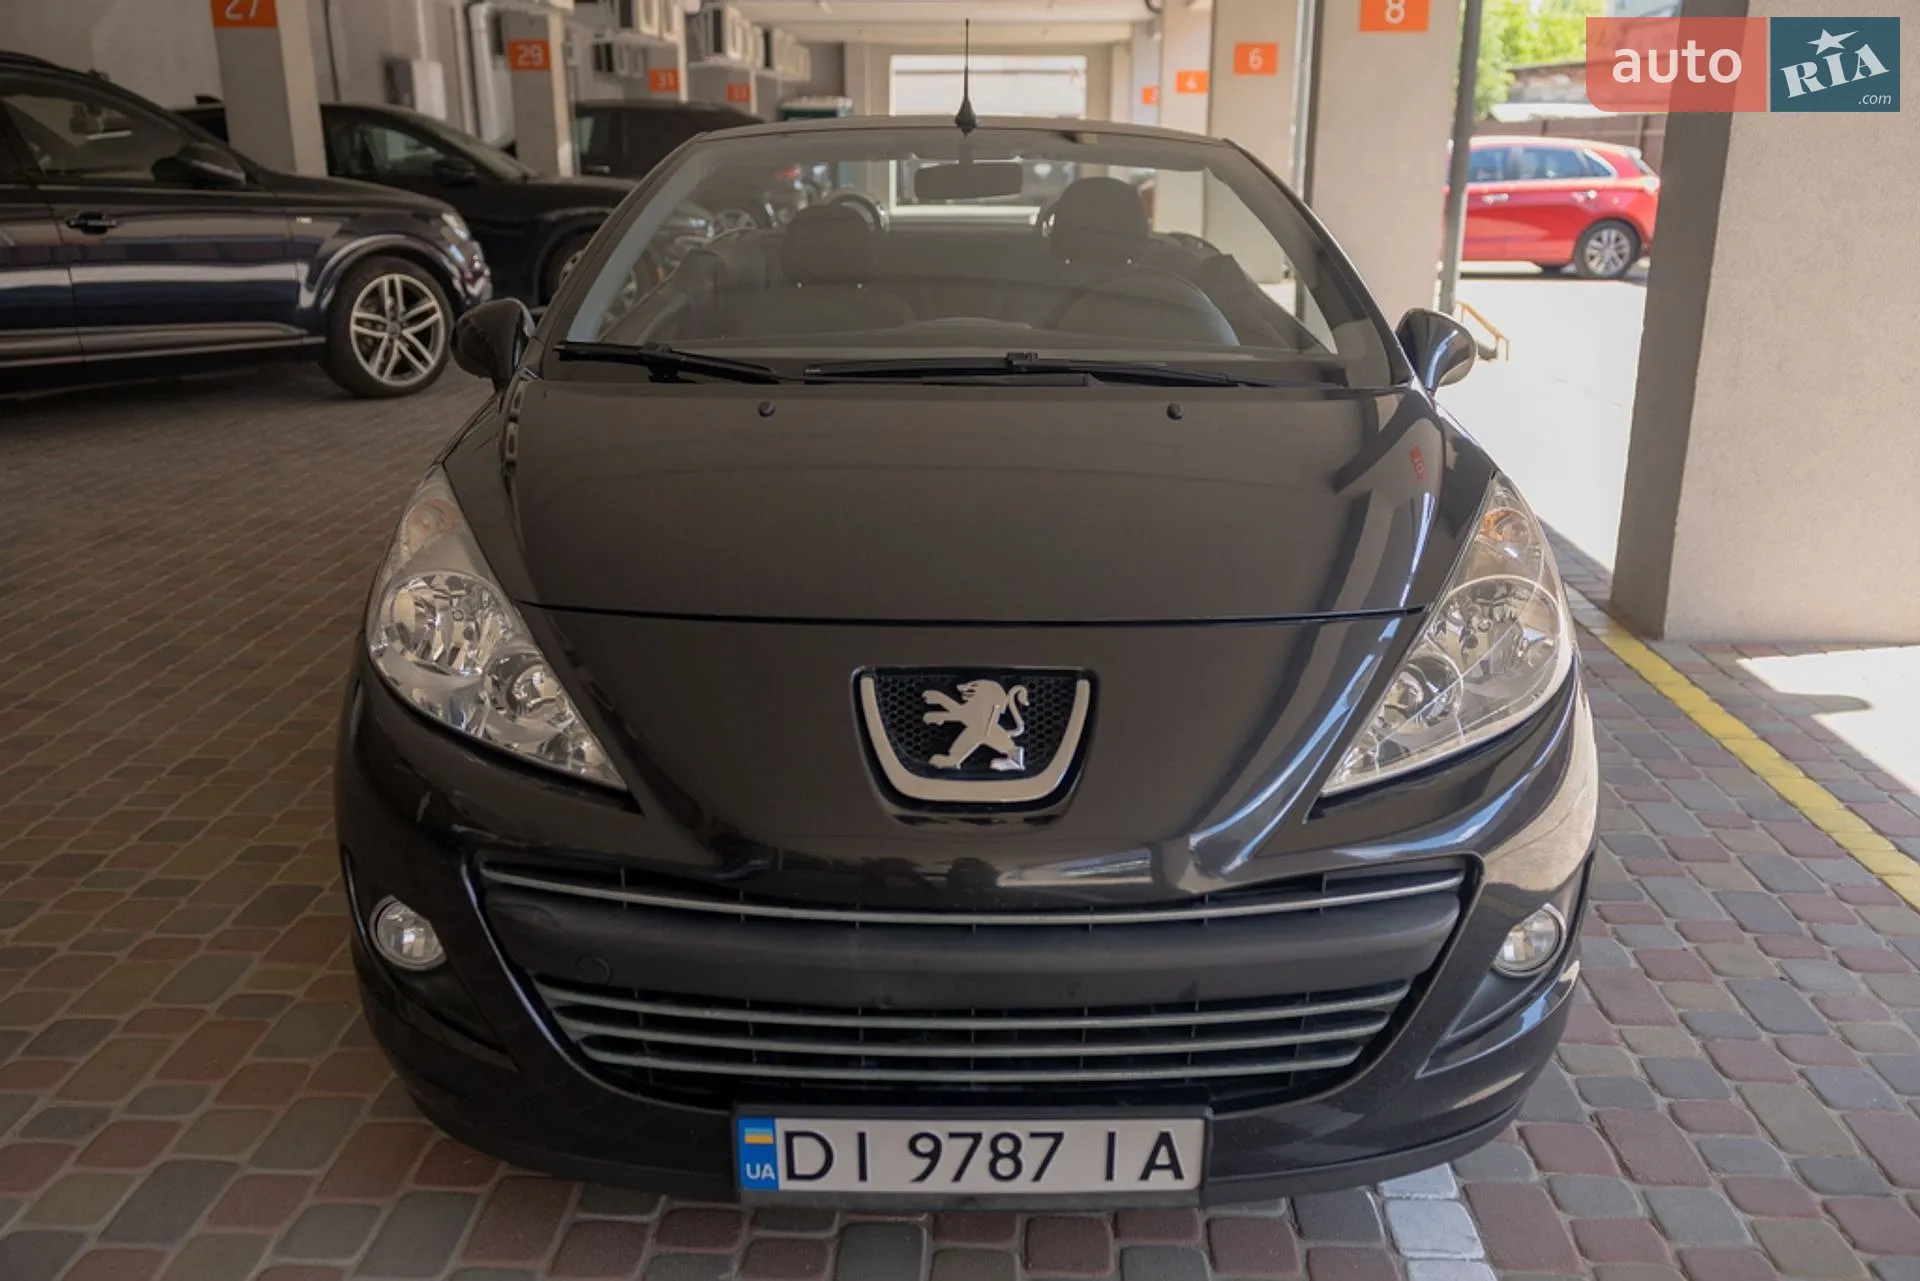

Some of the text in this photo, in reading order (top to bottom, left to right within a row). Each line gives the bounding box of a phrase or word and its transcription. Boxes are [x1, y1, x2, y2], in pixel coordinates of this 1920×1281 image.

[1384, 0, 1406, 25] 8
[1248, 47, 1264, 71] 6
[784, 1131, 1185, 1183] DI 9787 IA
[746, 1161, 776, 1180] UA
